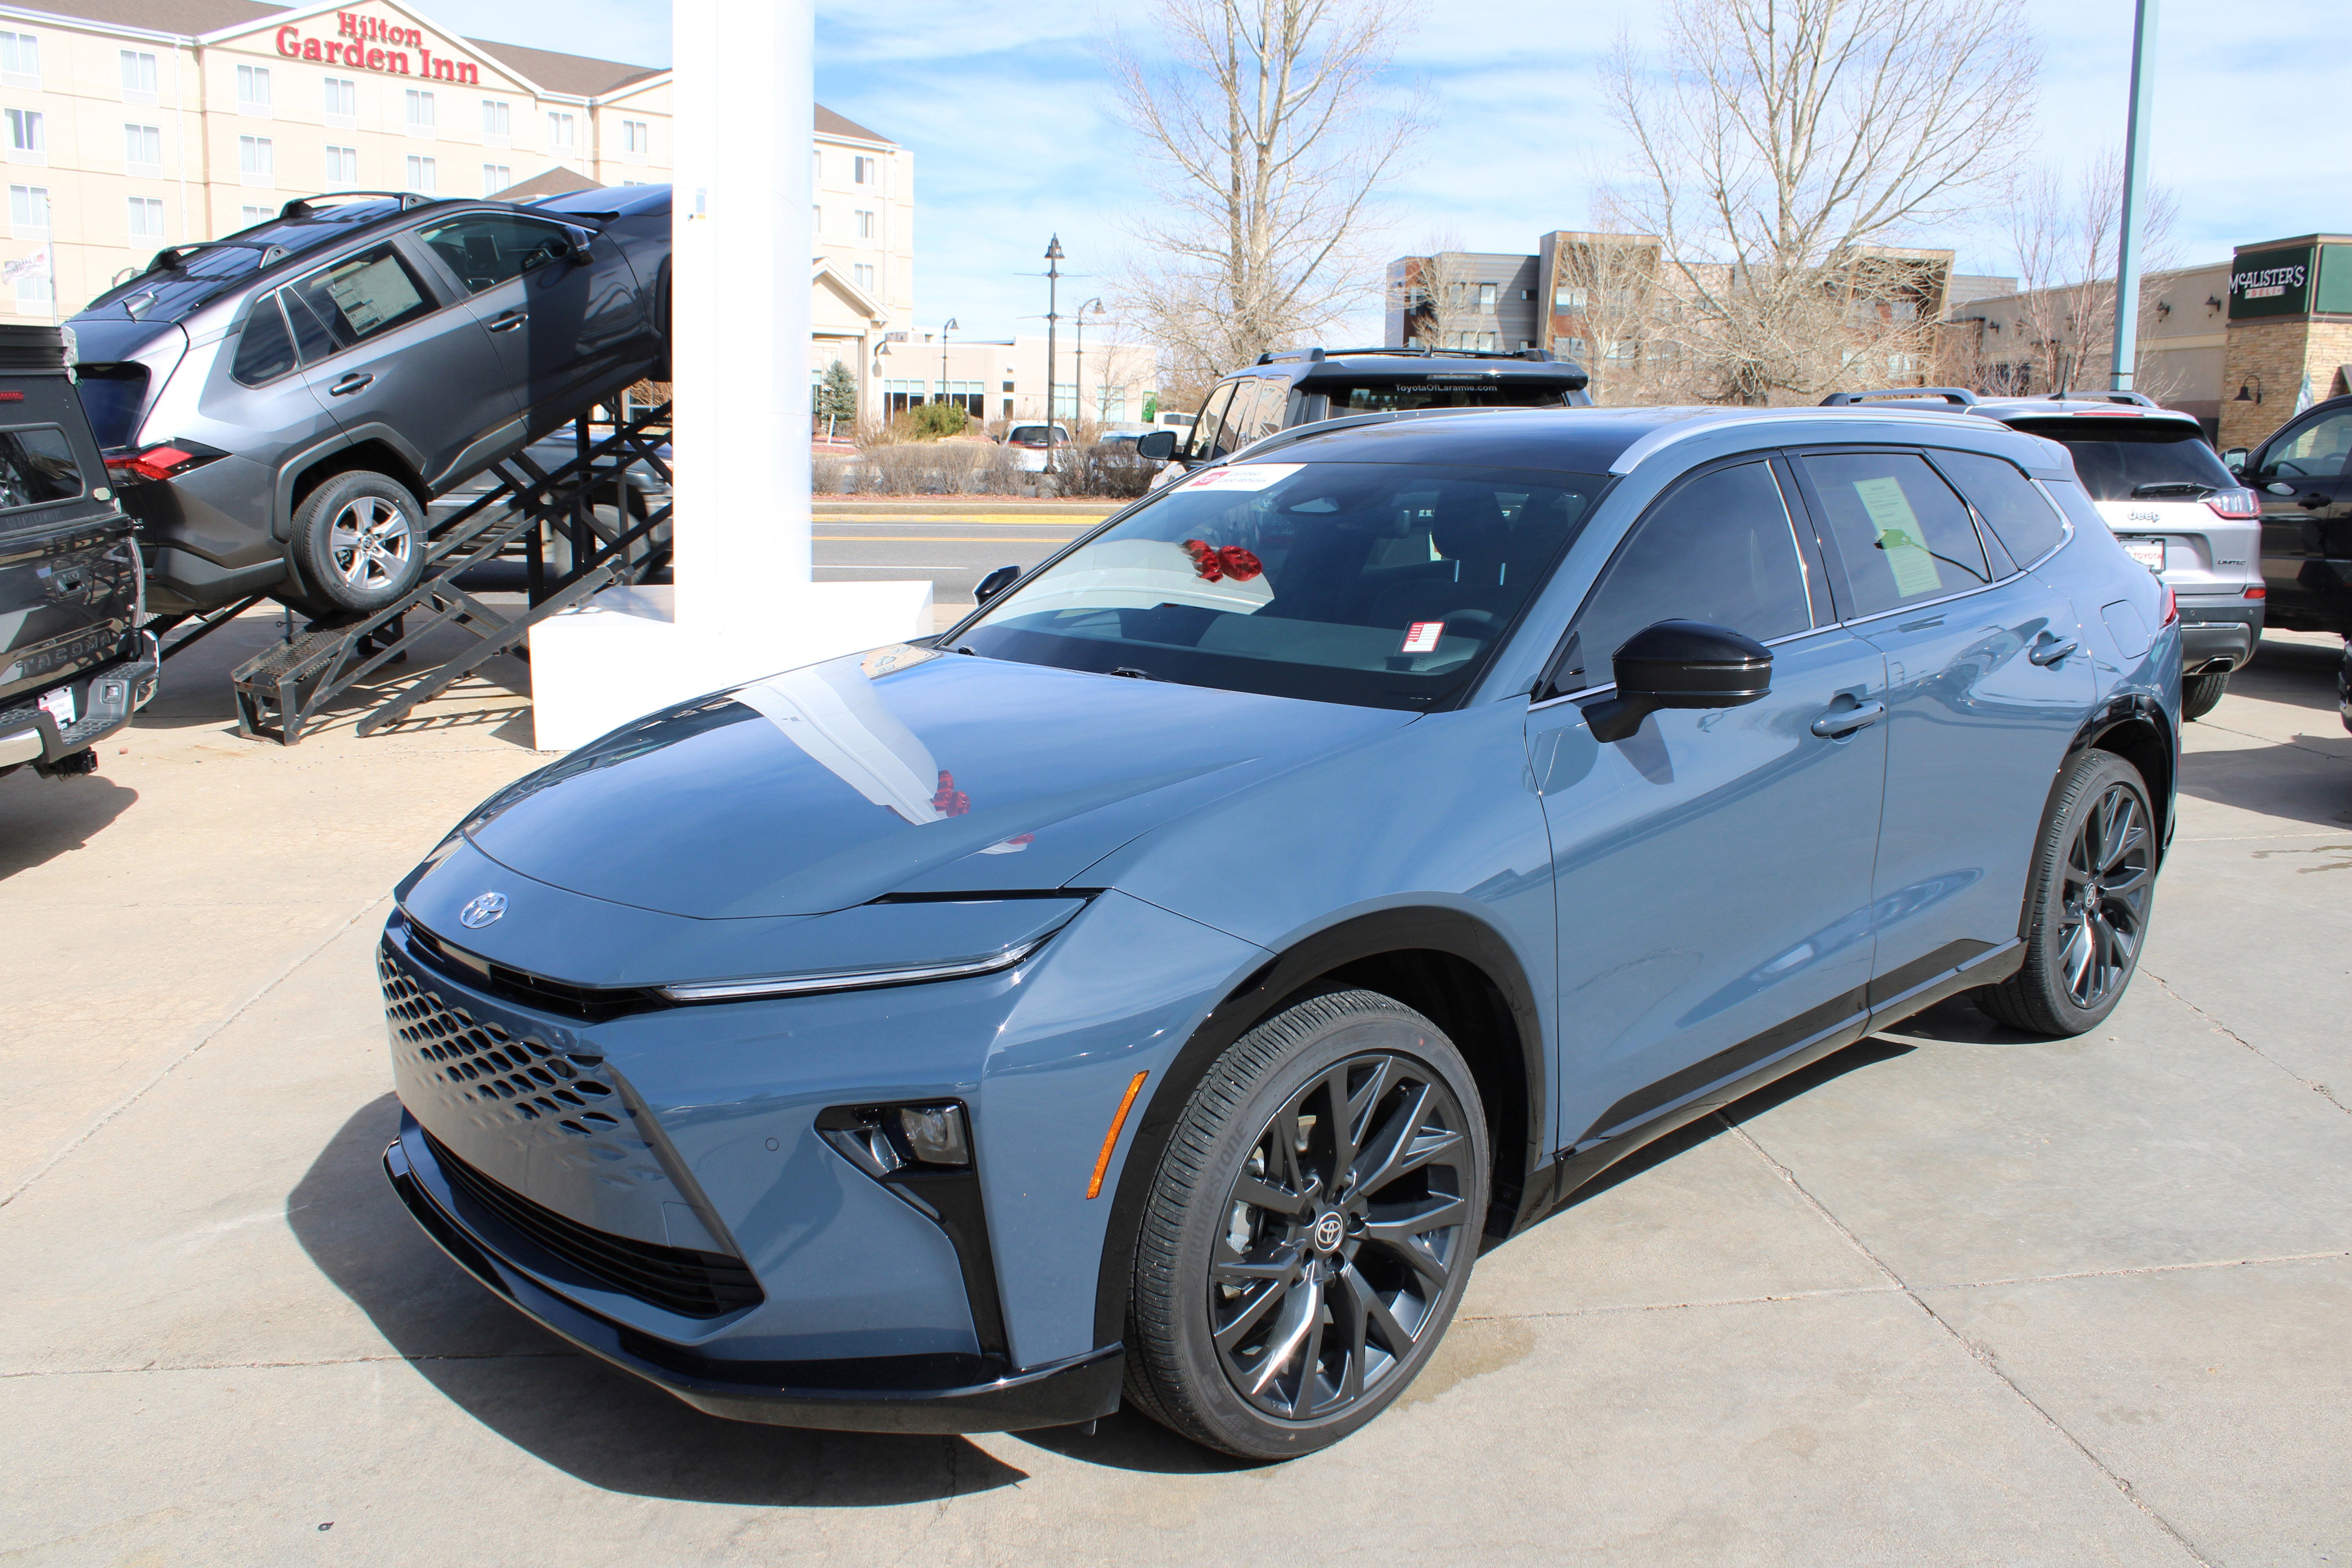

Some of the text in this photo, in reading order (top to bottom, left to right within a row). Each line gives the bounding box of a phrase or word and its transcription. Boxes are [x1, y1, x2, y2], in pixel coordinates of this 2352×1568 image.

[337, 10, 423, 46] Hilton
[276, 26, 480, 85] Garden Inn
[2251, 288, 2276, 297] DELI
[1395, 384, 1497, 393] ToyotaOfLaramie.com
[2127, 509, 2160, 523] Jeep
[16, 630, 111, 673] TACOMA
